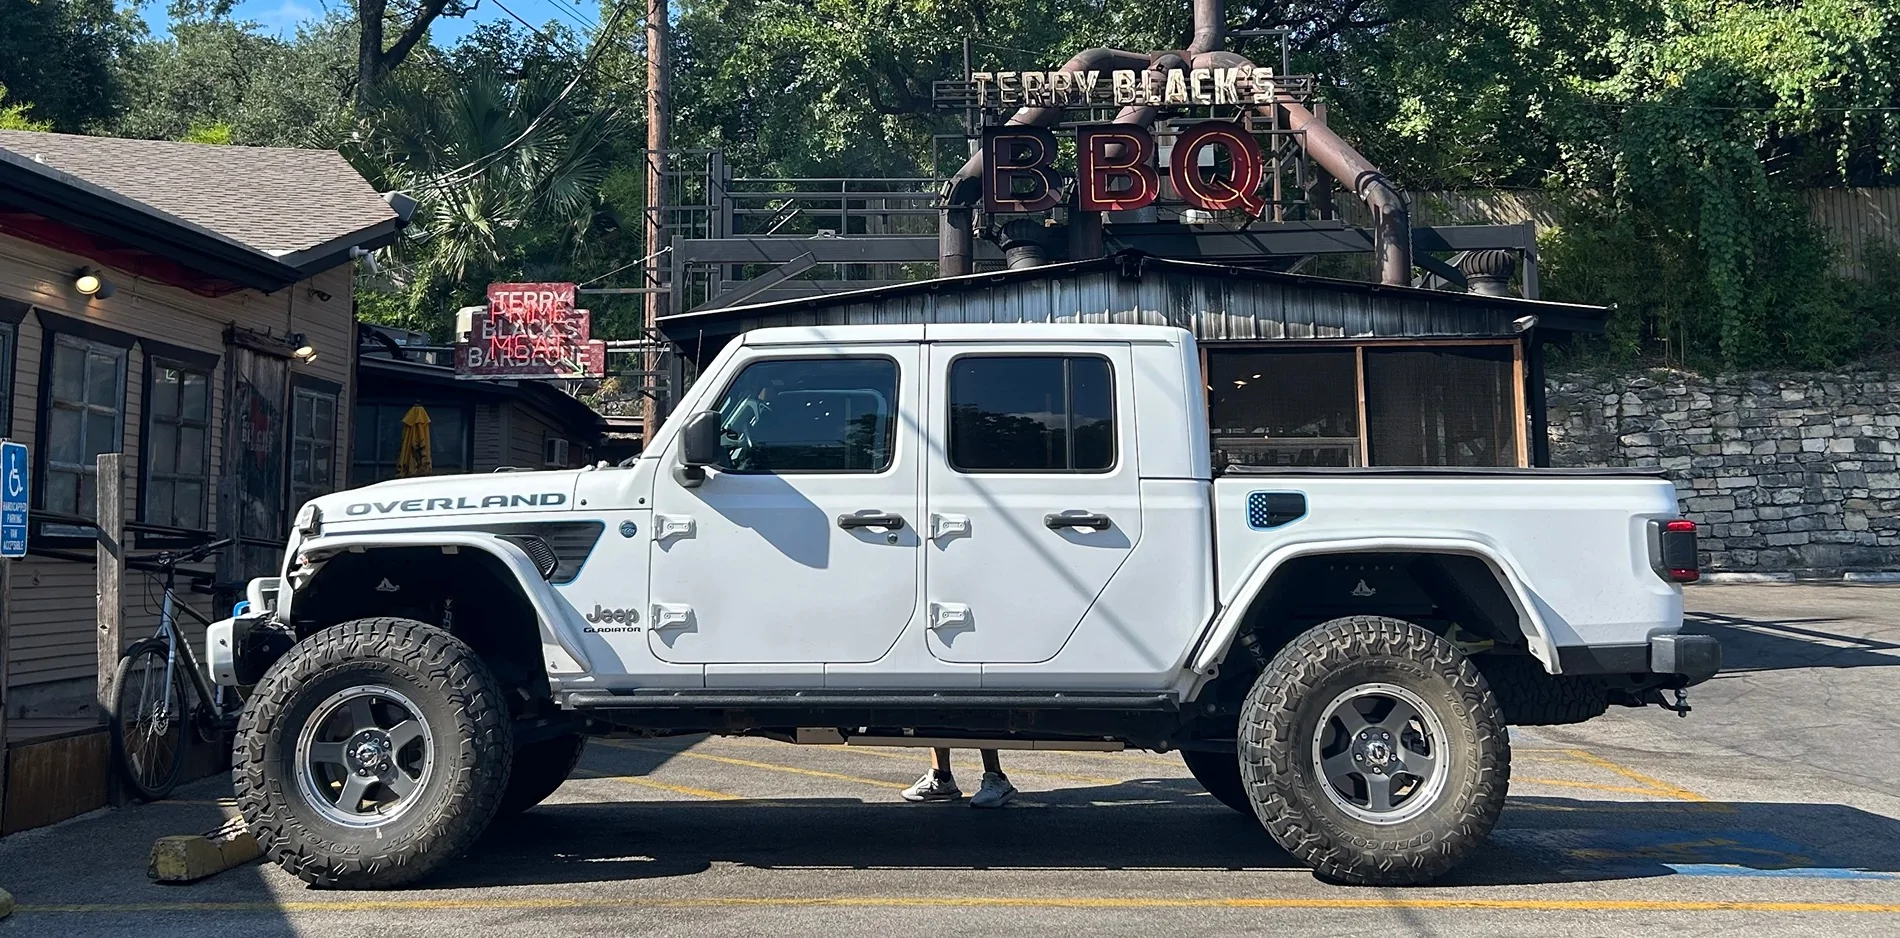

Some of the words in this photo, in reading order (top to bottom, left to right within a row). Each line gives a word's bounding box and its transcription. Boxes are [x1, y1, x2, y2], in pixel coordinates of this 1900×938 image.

[972, 70, 1100, 106] TERRY
[1112, 65, 1275, 105] BLACK'S
[983, 121, 1266, 219] BBQ
[490, 298, 567, 324] PRIME
[494, 291, 567, 313] TERRY
[490, 334, 567, 360] MEAT
[345, 493, 567, 516] OVERLAND
[585, 604, 640, 626] Jeep
[1445, 691, 1476, 746] TOYO
[1450, 747, 1480, 814] TIRES
[1382, 831, 1435, 853] OPEN
